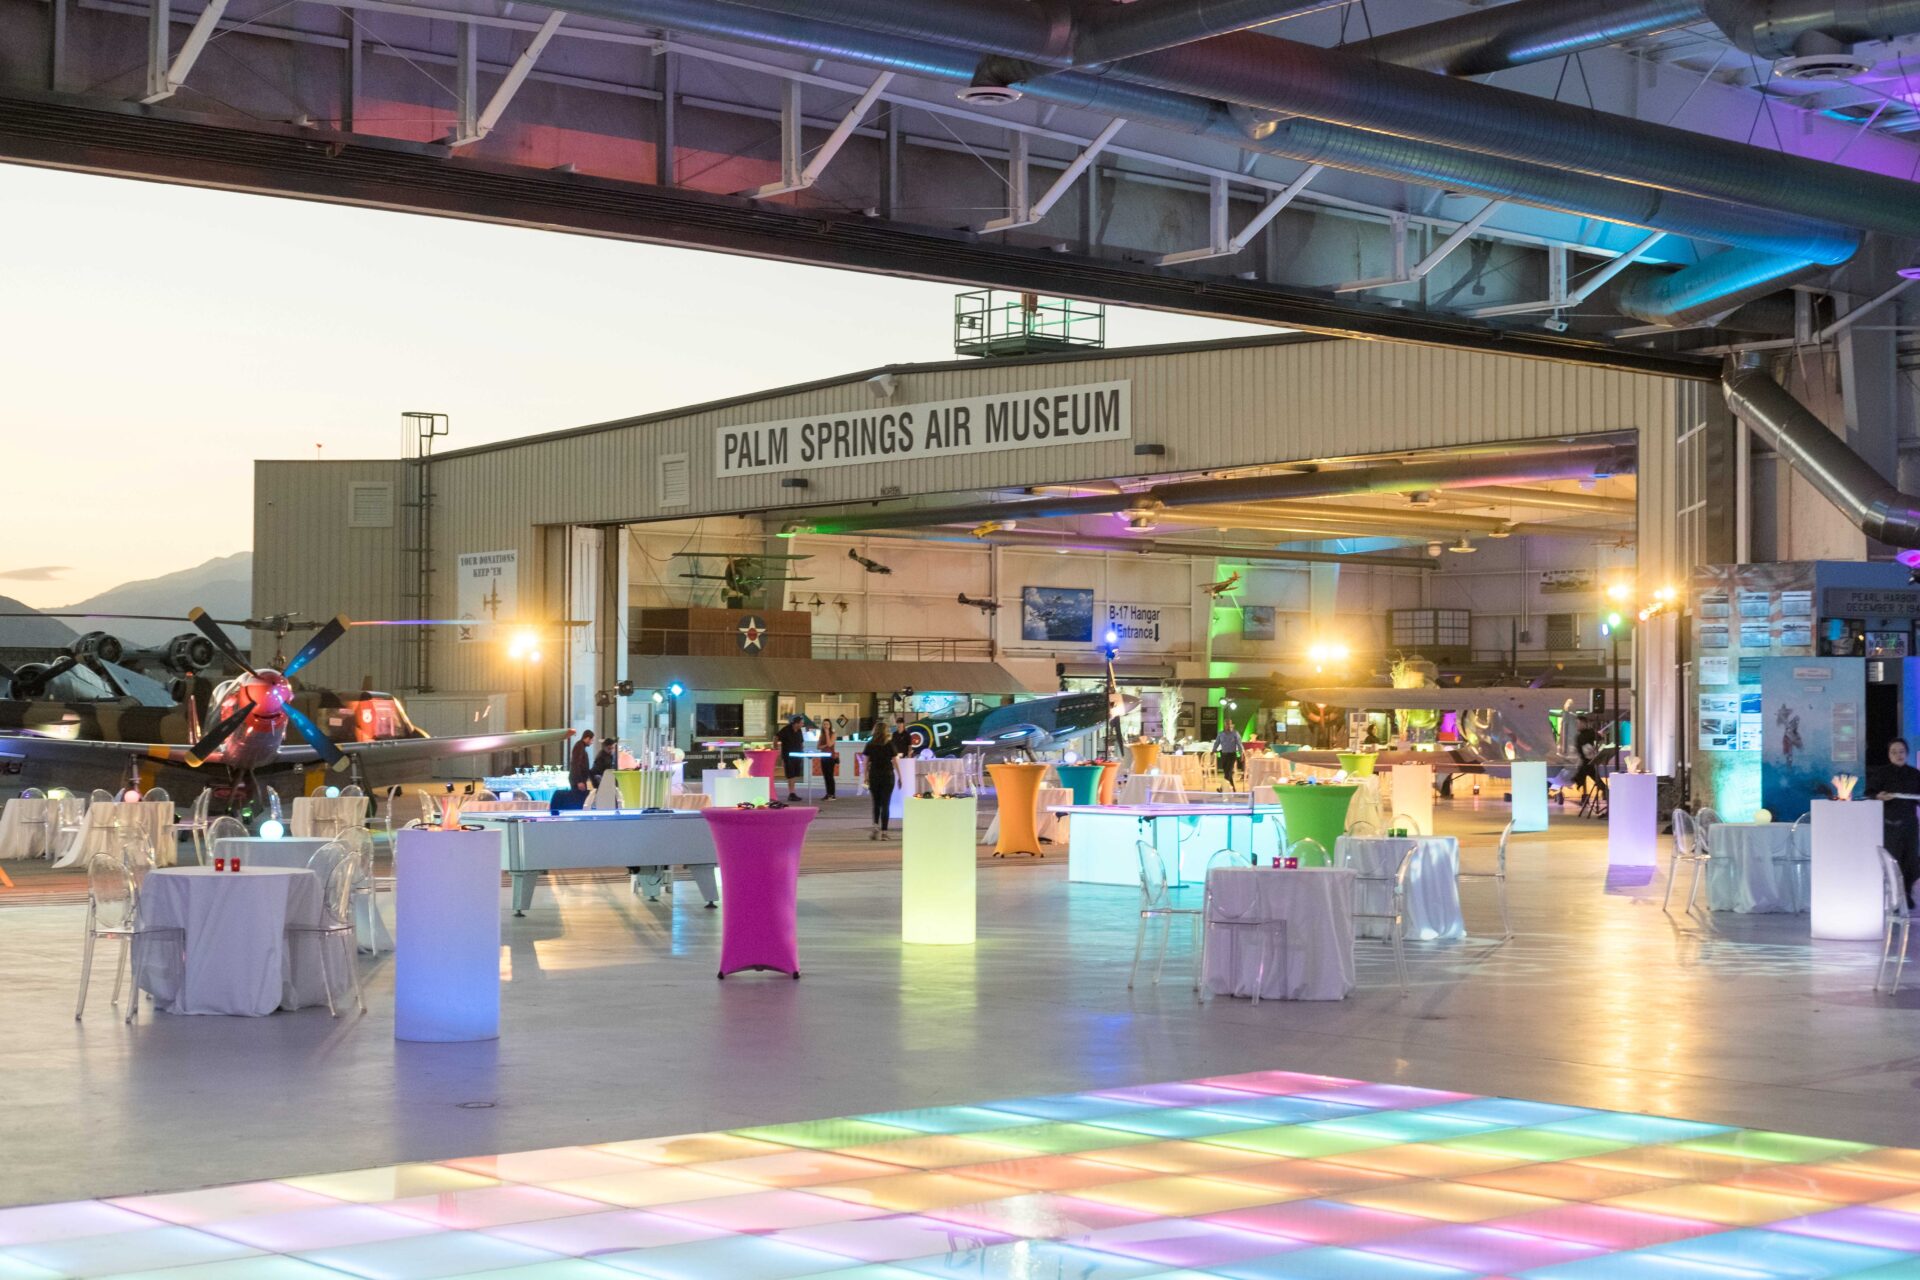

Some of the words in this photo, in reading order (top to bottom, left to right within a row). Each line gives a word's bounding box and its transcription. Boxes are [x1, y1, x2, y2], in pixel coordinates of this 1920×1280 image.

[724, 427, 788, 470] PALM
[800, 411, 914, 462] SPRINGS
[925, 406, 971, 450] AIR
[985, 389, 1120, 443] MUSEUM
[461, 556, 478, 566] YOUR
[479, 553, 515, 565] DONATIONS
[473, 568, 489, 577] KEEP
[1851, 592, 1880, 602] PEARL
[1883, 593, 1918, 602] HARBOR
[1846, 602, 1895, 612] DECEMBER
[1109, 605, 1129, 620] B-17
[1130, 606, 1160, 624] Hangar
[1117, 624, 1153, 639] Entrance
[932, 722, 952, 748] P
